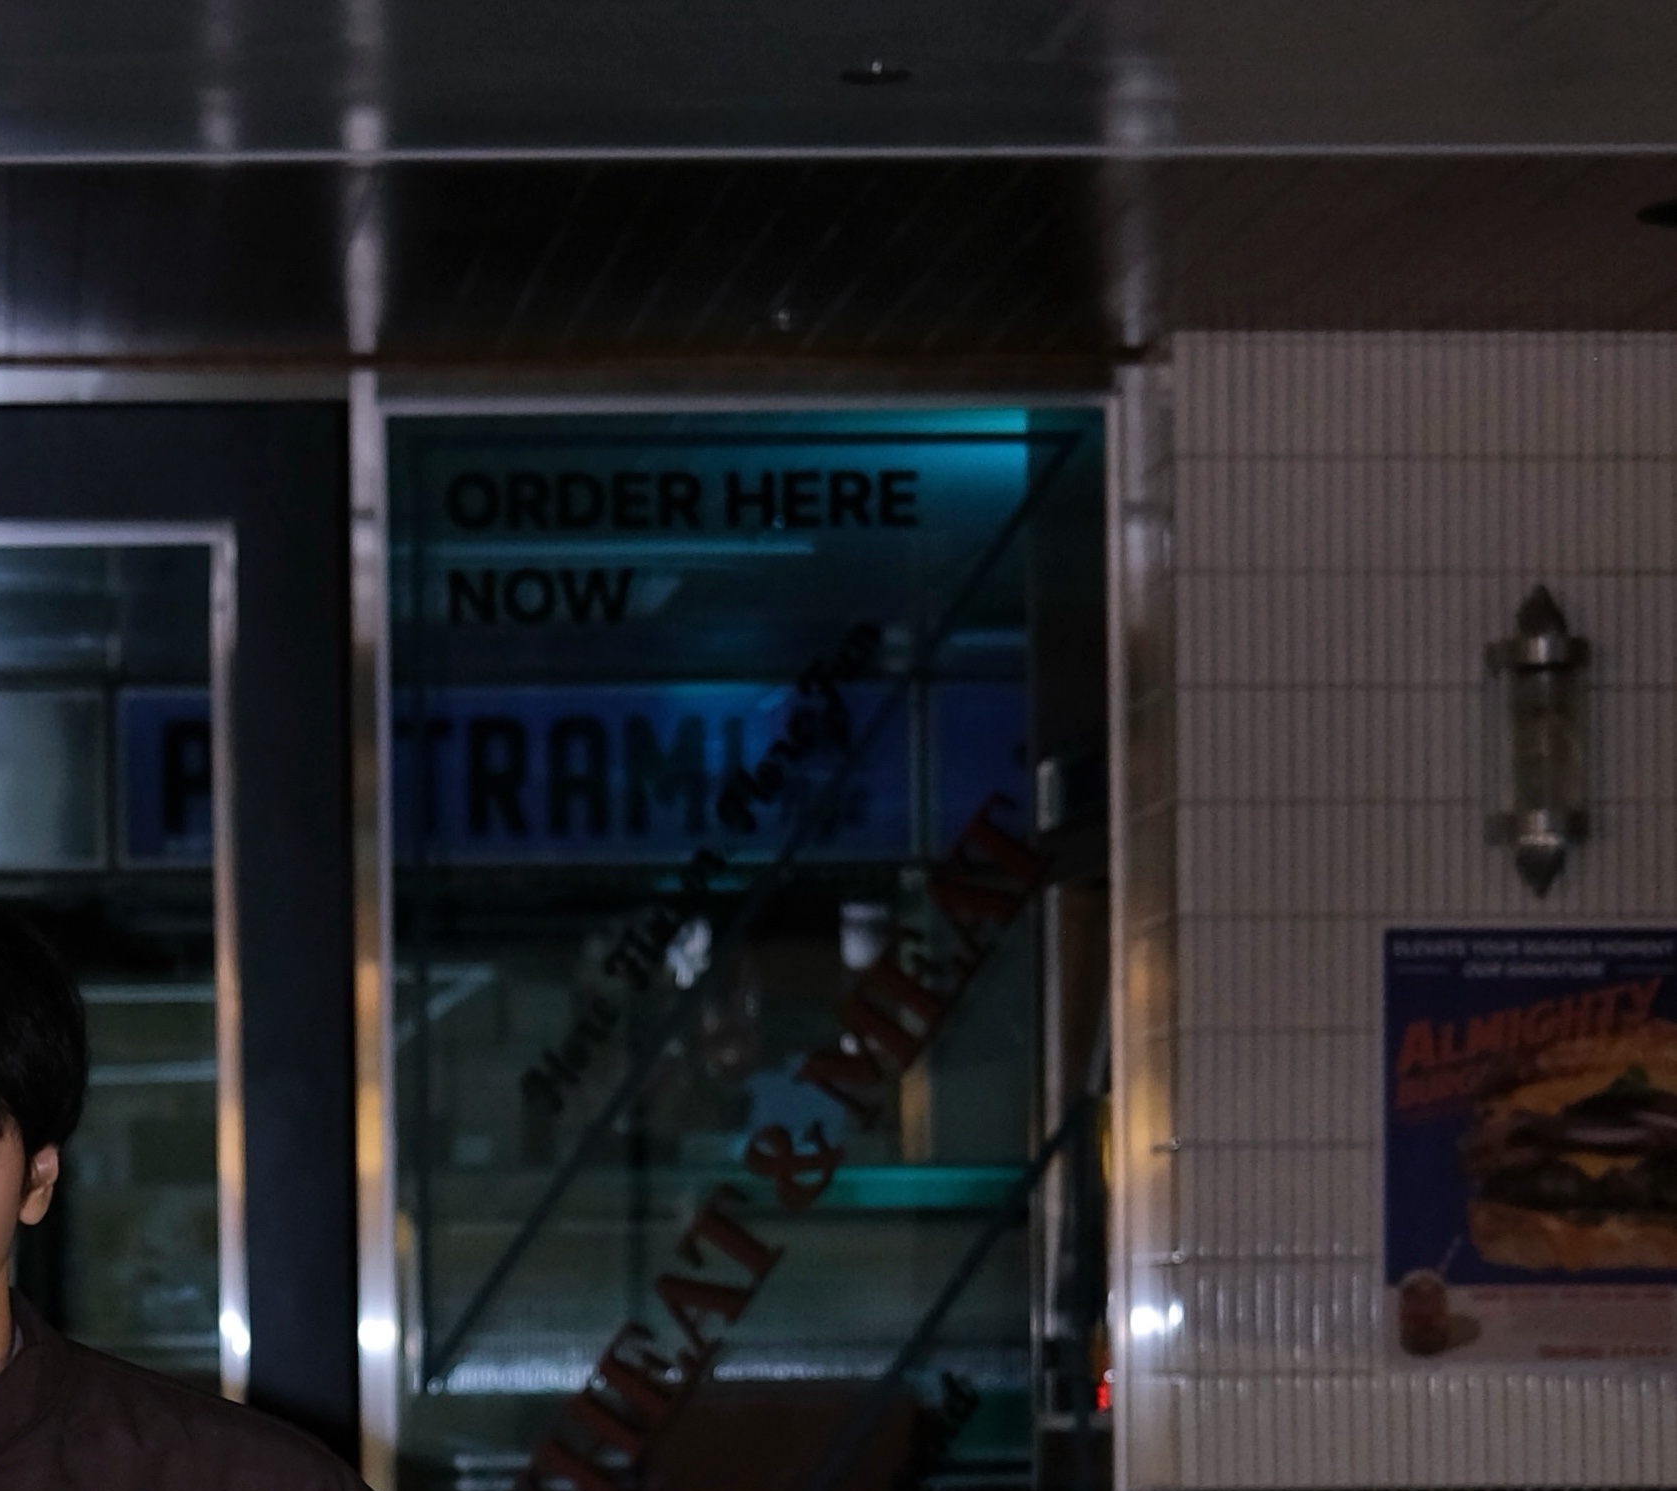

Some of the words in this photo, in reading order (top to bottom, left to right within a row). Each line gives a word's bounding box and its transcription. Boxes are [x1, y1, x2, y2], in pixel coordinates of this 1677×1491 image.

[446, 470, 704, 530] ORDER
[724, 469, 918, 527] HERE
[447, 567, 635, 625] NOW
[795, 790, 1058, 1130] MEAT
[1395, 977, 1663, 1074] ALMIGHTY
[745, 1113, 846, 1215] &
